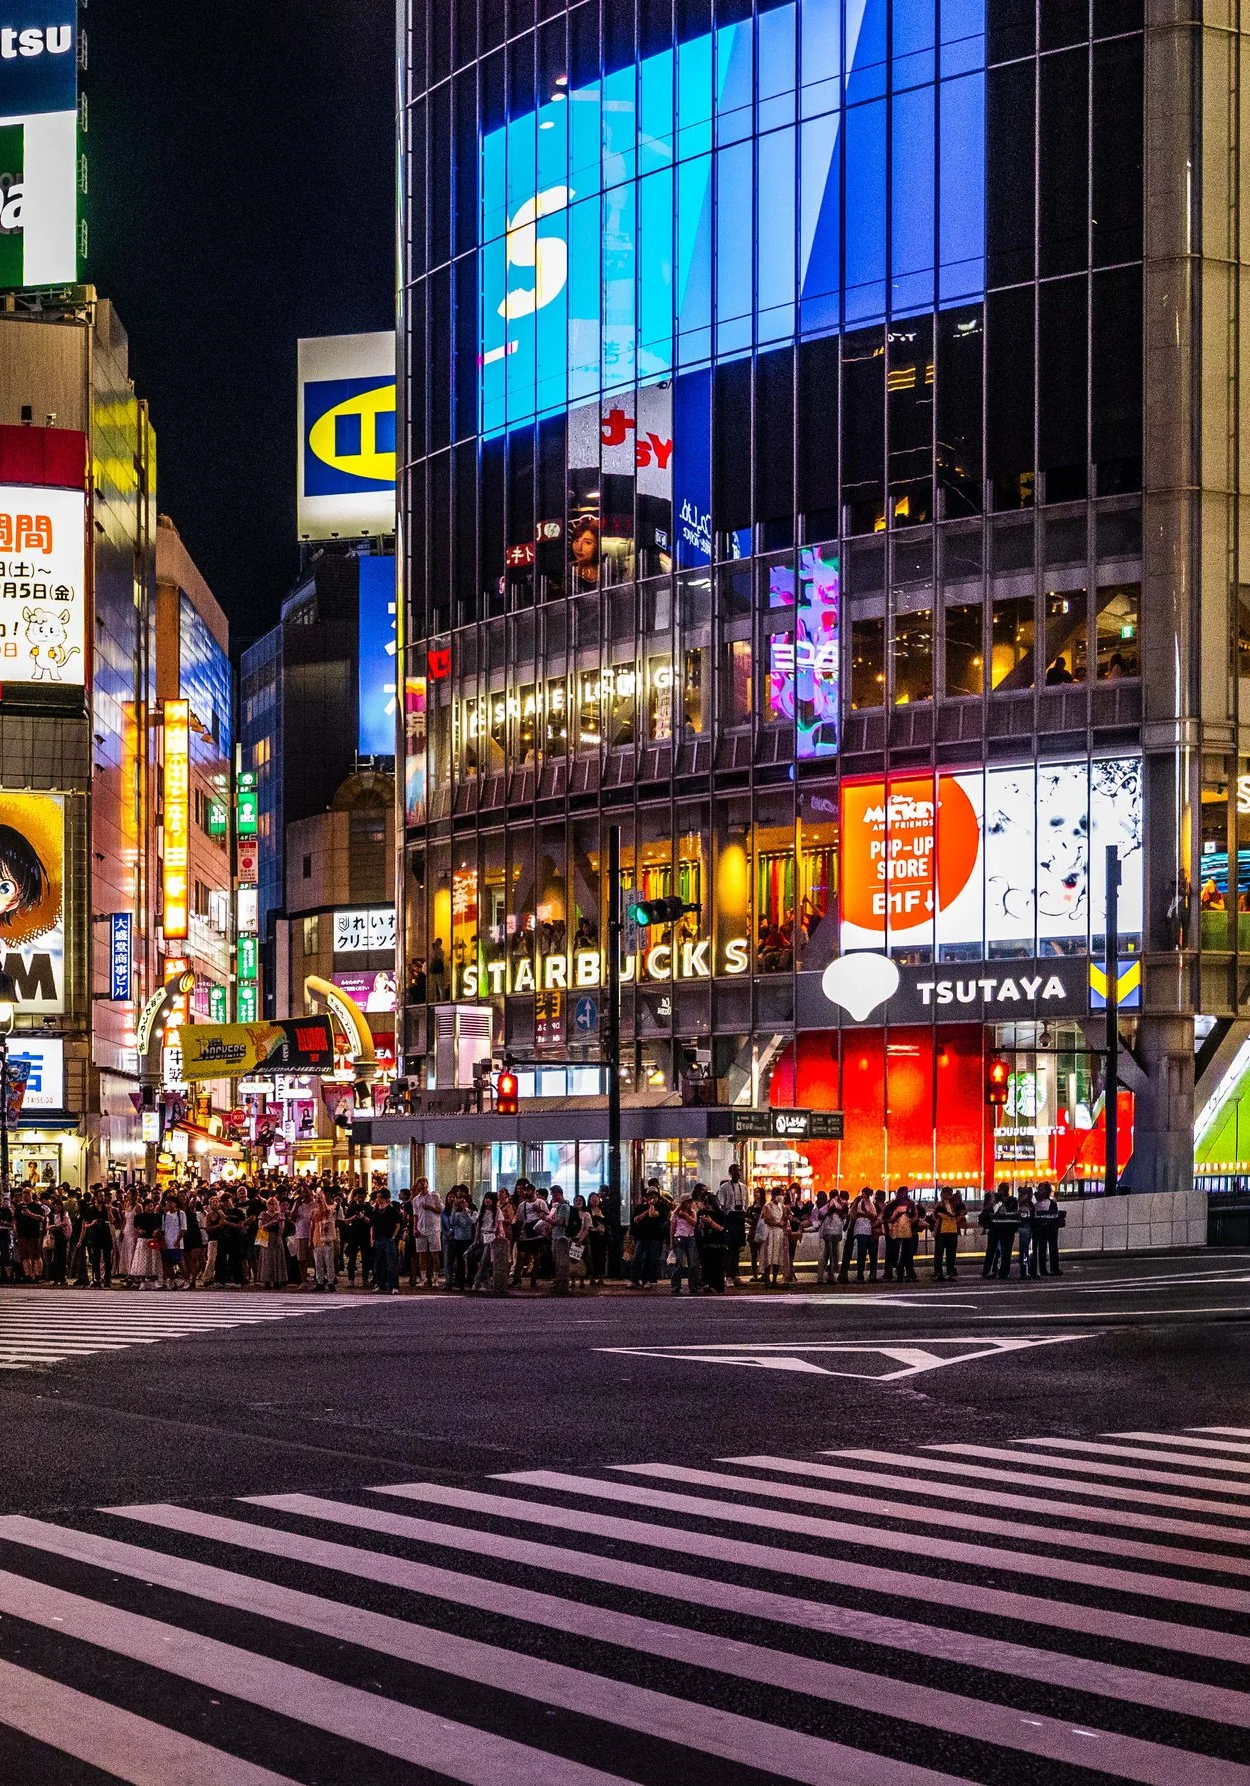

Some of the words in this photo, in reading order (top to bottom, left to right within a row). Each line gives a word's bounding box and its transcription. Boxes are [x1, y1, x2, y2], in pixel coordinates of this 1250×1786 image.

[895, 819, 934, 829] FRIENDS
[871, 836, 934, 860] POP-UP
[877, 858, 928, 880] STORE
[114, 918, 128, 998] 大盛堂商事ビル
[463, 939, 748, 997] STARBUCKS
[917, 976, 1066, 1005] TSUTAYA
